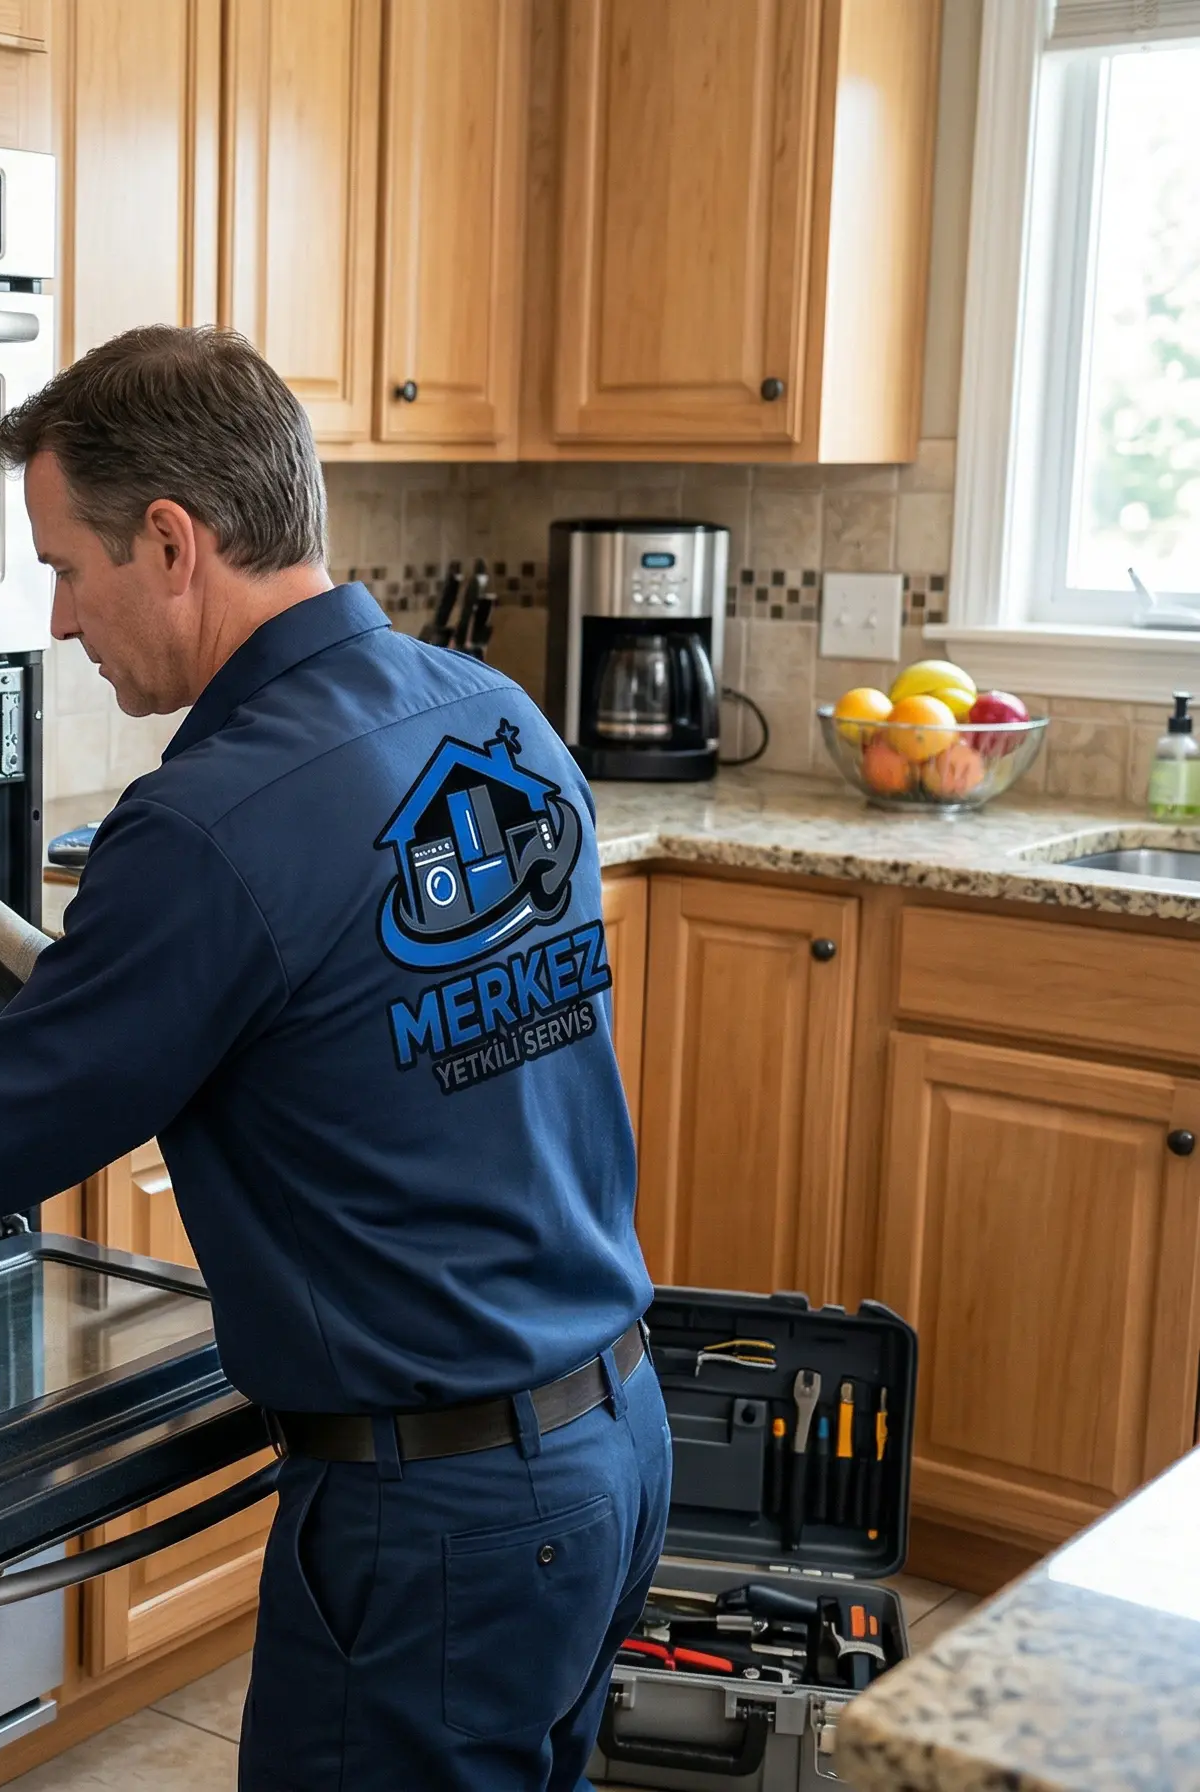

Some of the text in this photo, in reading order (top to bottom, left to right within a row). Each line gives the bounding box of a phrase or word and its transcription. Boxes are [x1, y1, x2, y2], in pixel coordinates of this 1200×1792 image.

[390, 924, 609, 1066] MERKEZ
[435, 1004, 593, 1089] YETKİLİ SERVİS
